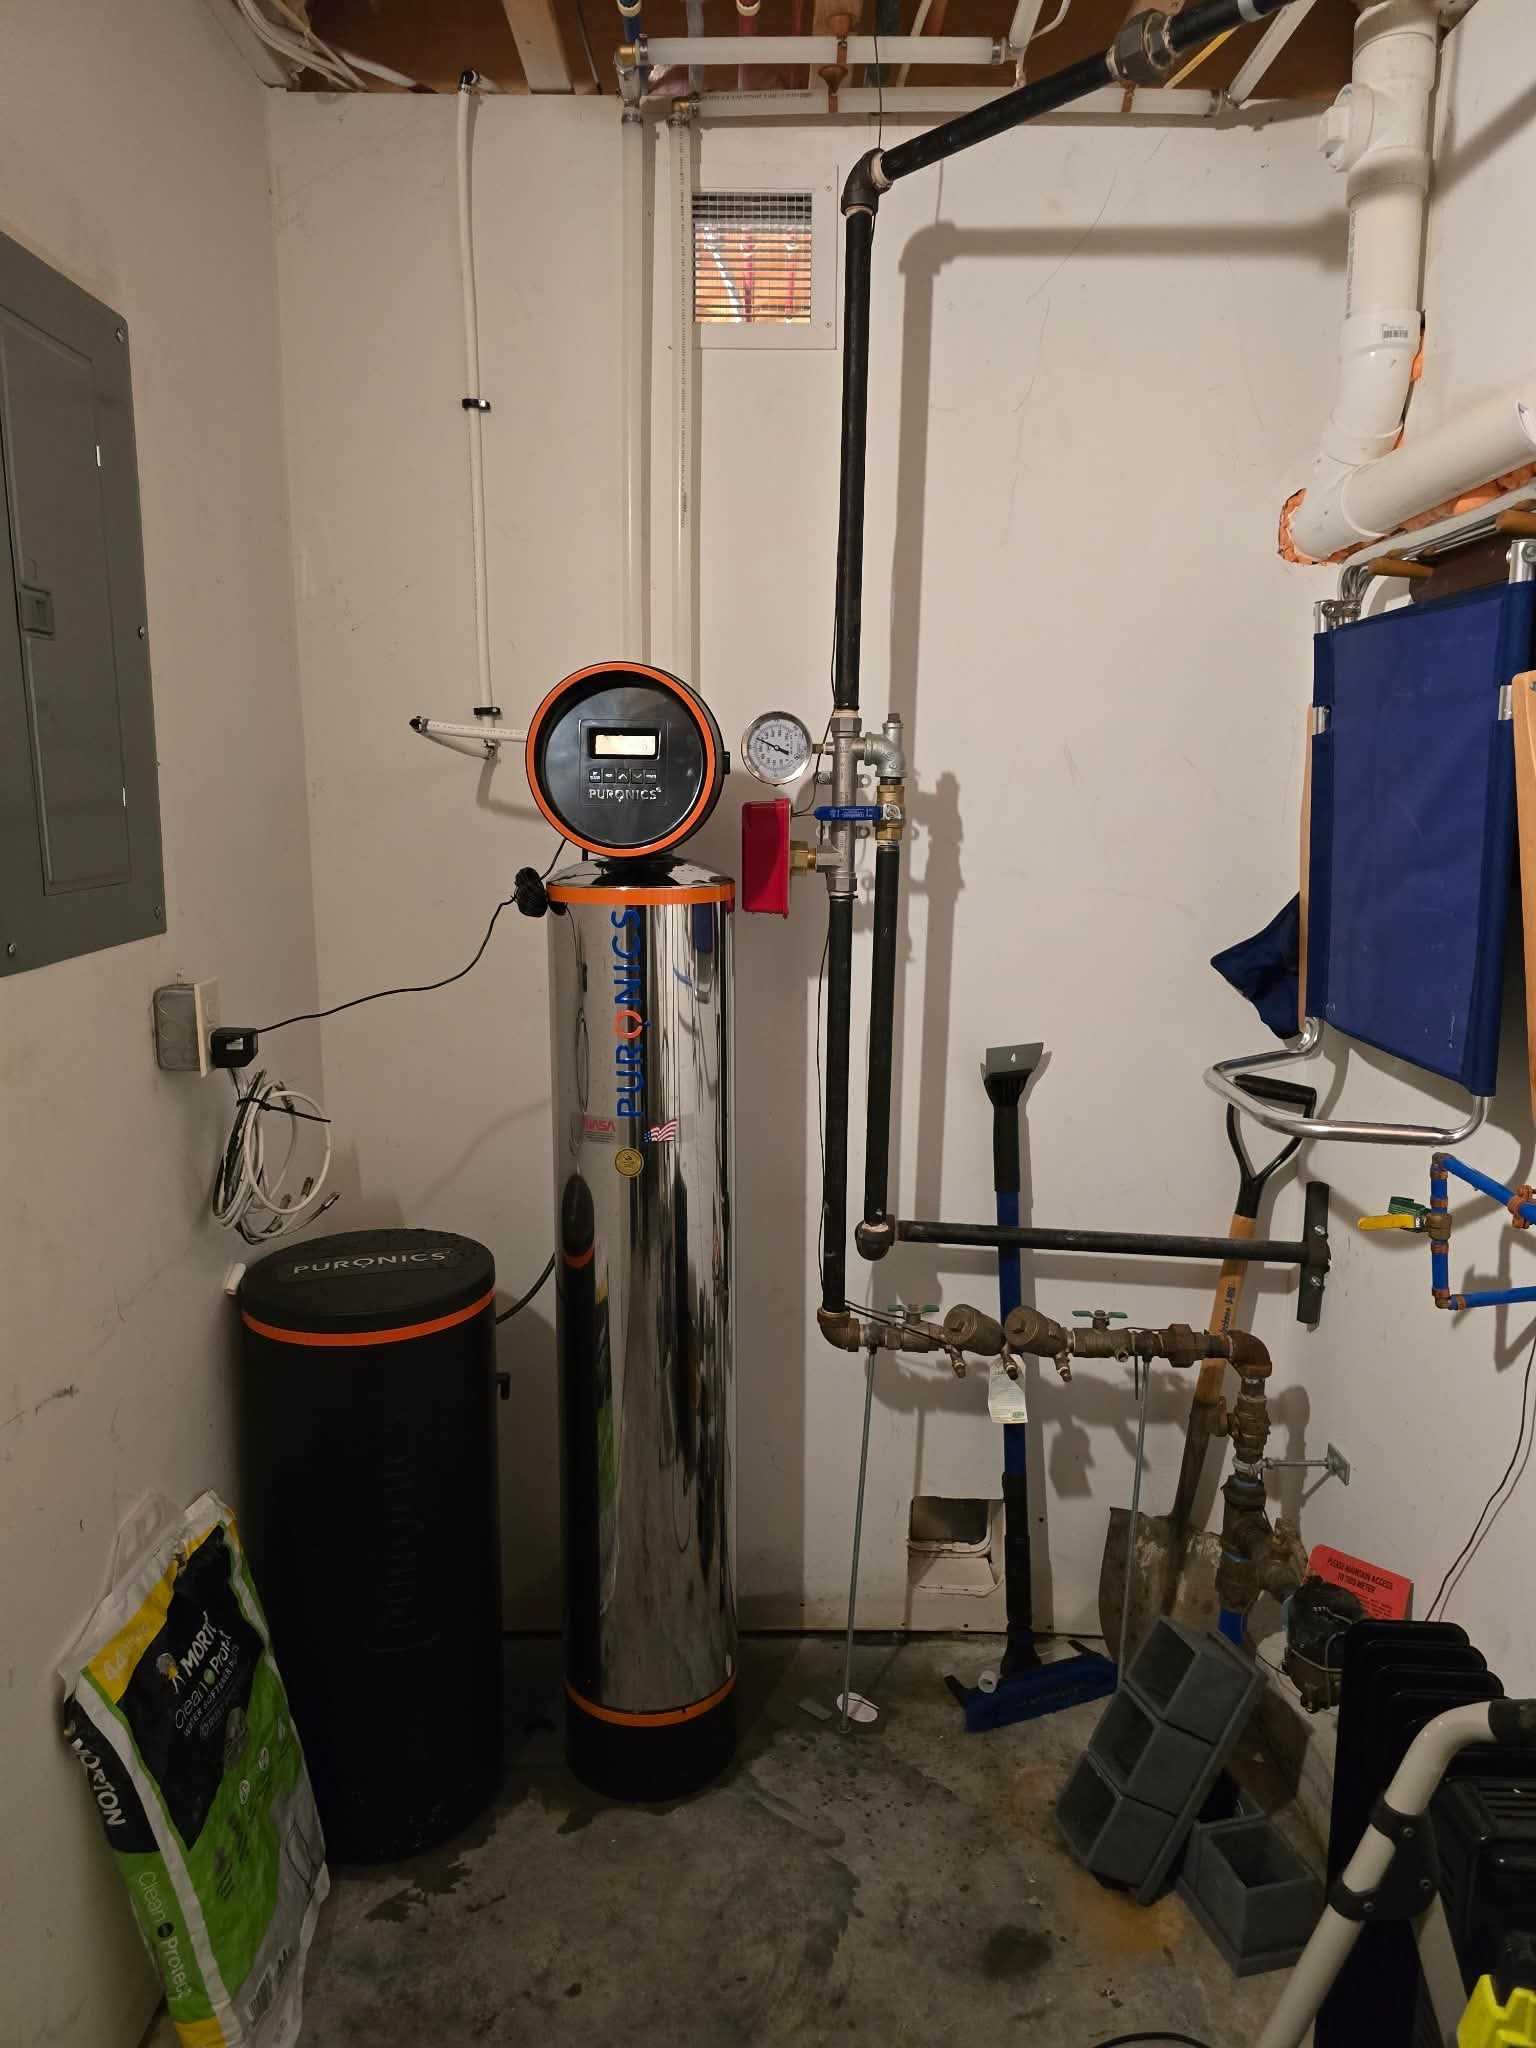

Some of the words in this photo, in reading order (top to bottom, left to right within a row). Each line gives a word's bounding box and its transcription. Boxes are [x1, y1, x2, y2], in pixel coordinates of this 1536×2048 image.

[611, 909, 648, 1118] PURONICS
[583, 1119, 617, 1132] NASA
[293, 1252, 447, 1275] PURONICS
[1371, 1575, 1393, 1590] ACCESS
[138, 1871, 167, 1922] Clean
